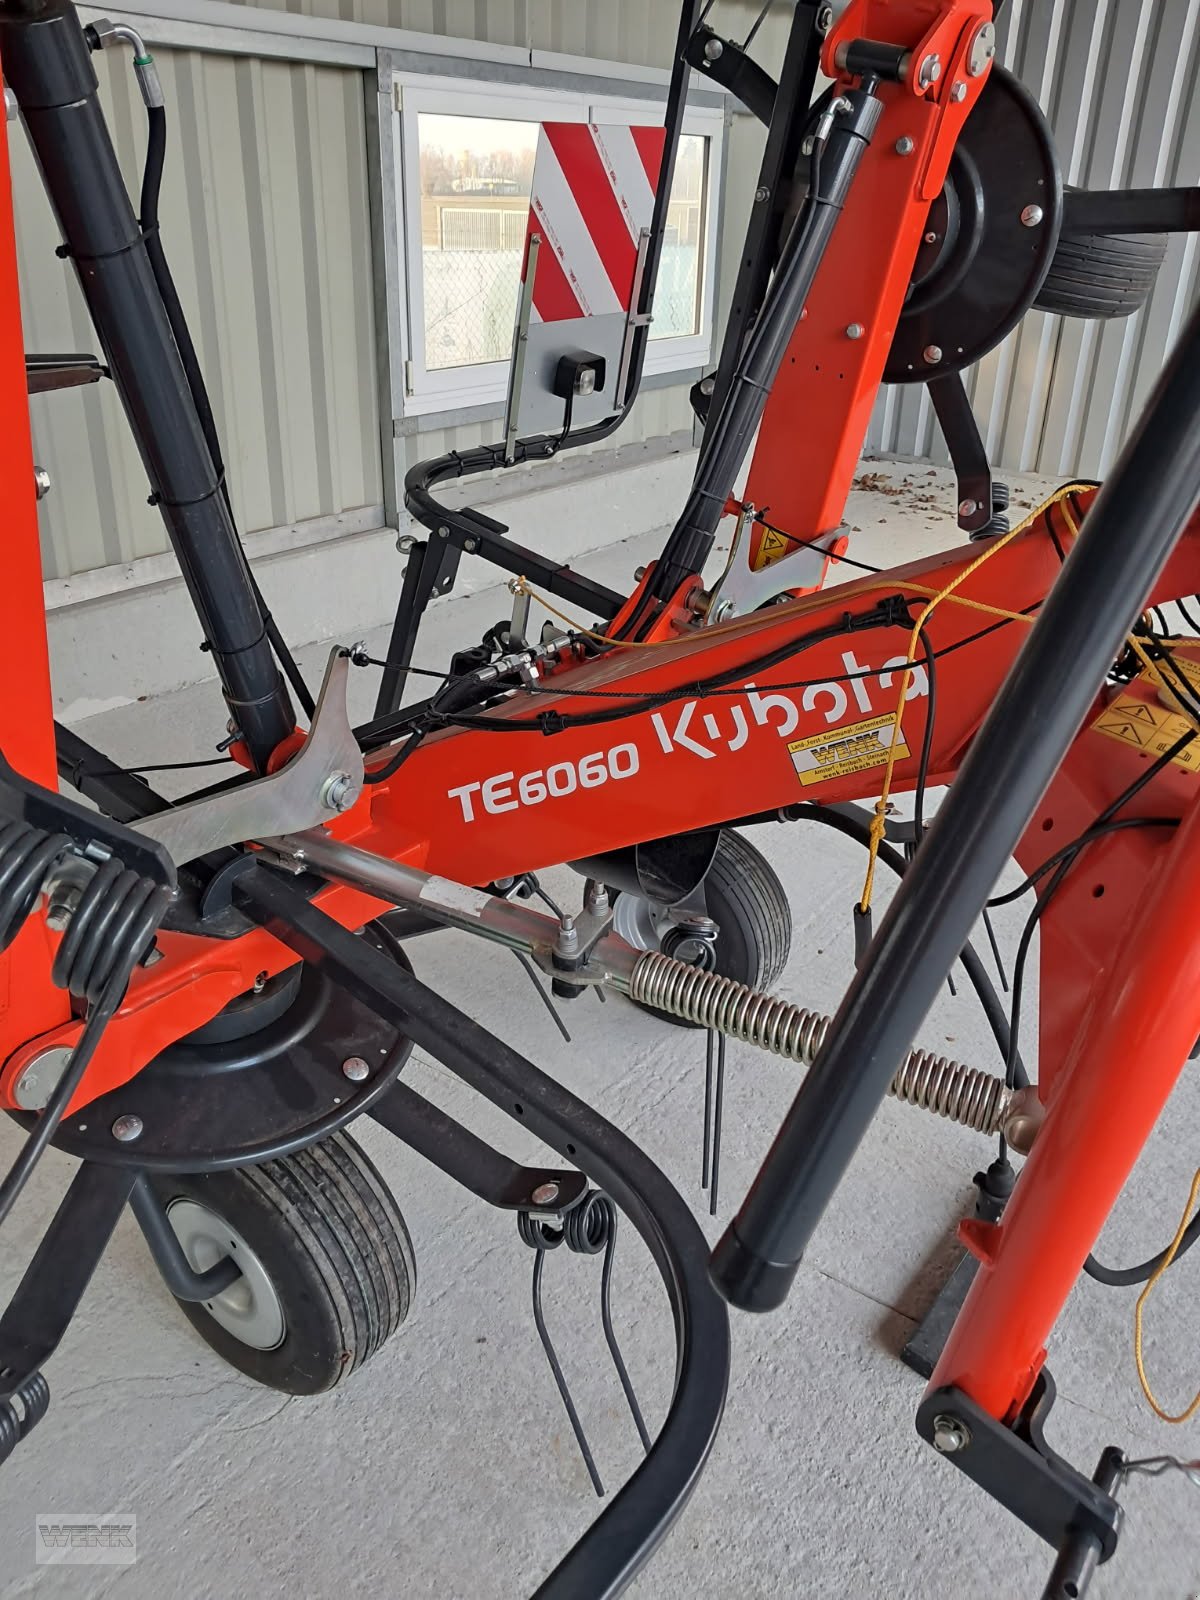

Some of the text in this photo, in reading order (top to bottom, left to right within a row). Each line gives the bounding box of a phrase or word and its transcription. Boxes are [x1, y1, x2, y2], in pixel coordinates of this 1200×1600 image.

[651, 650, 929, 759] Kubota
[810, 730, 886, 765] WENK
[822, 757, 887, 779] wenk-reisbach.com
[447, 742, 640, 823] TE6060
